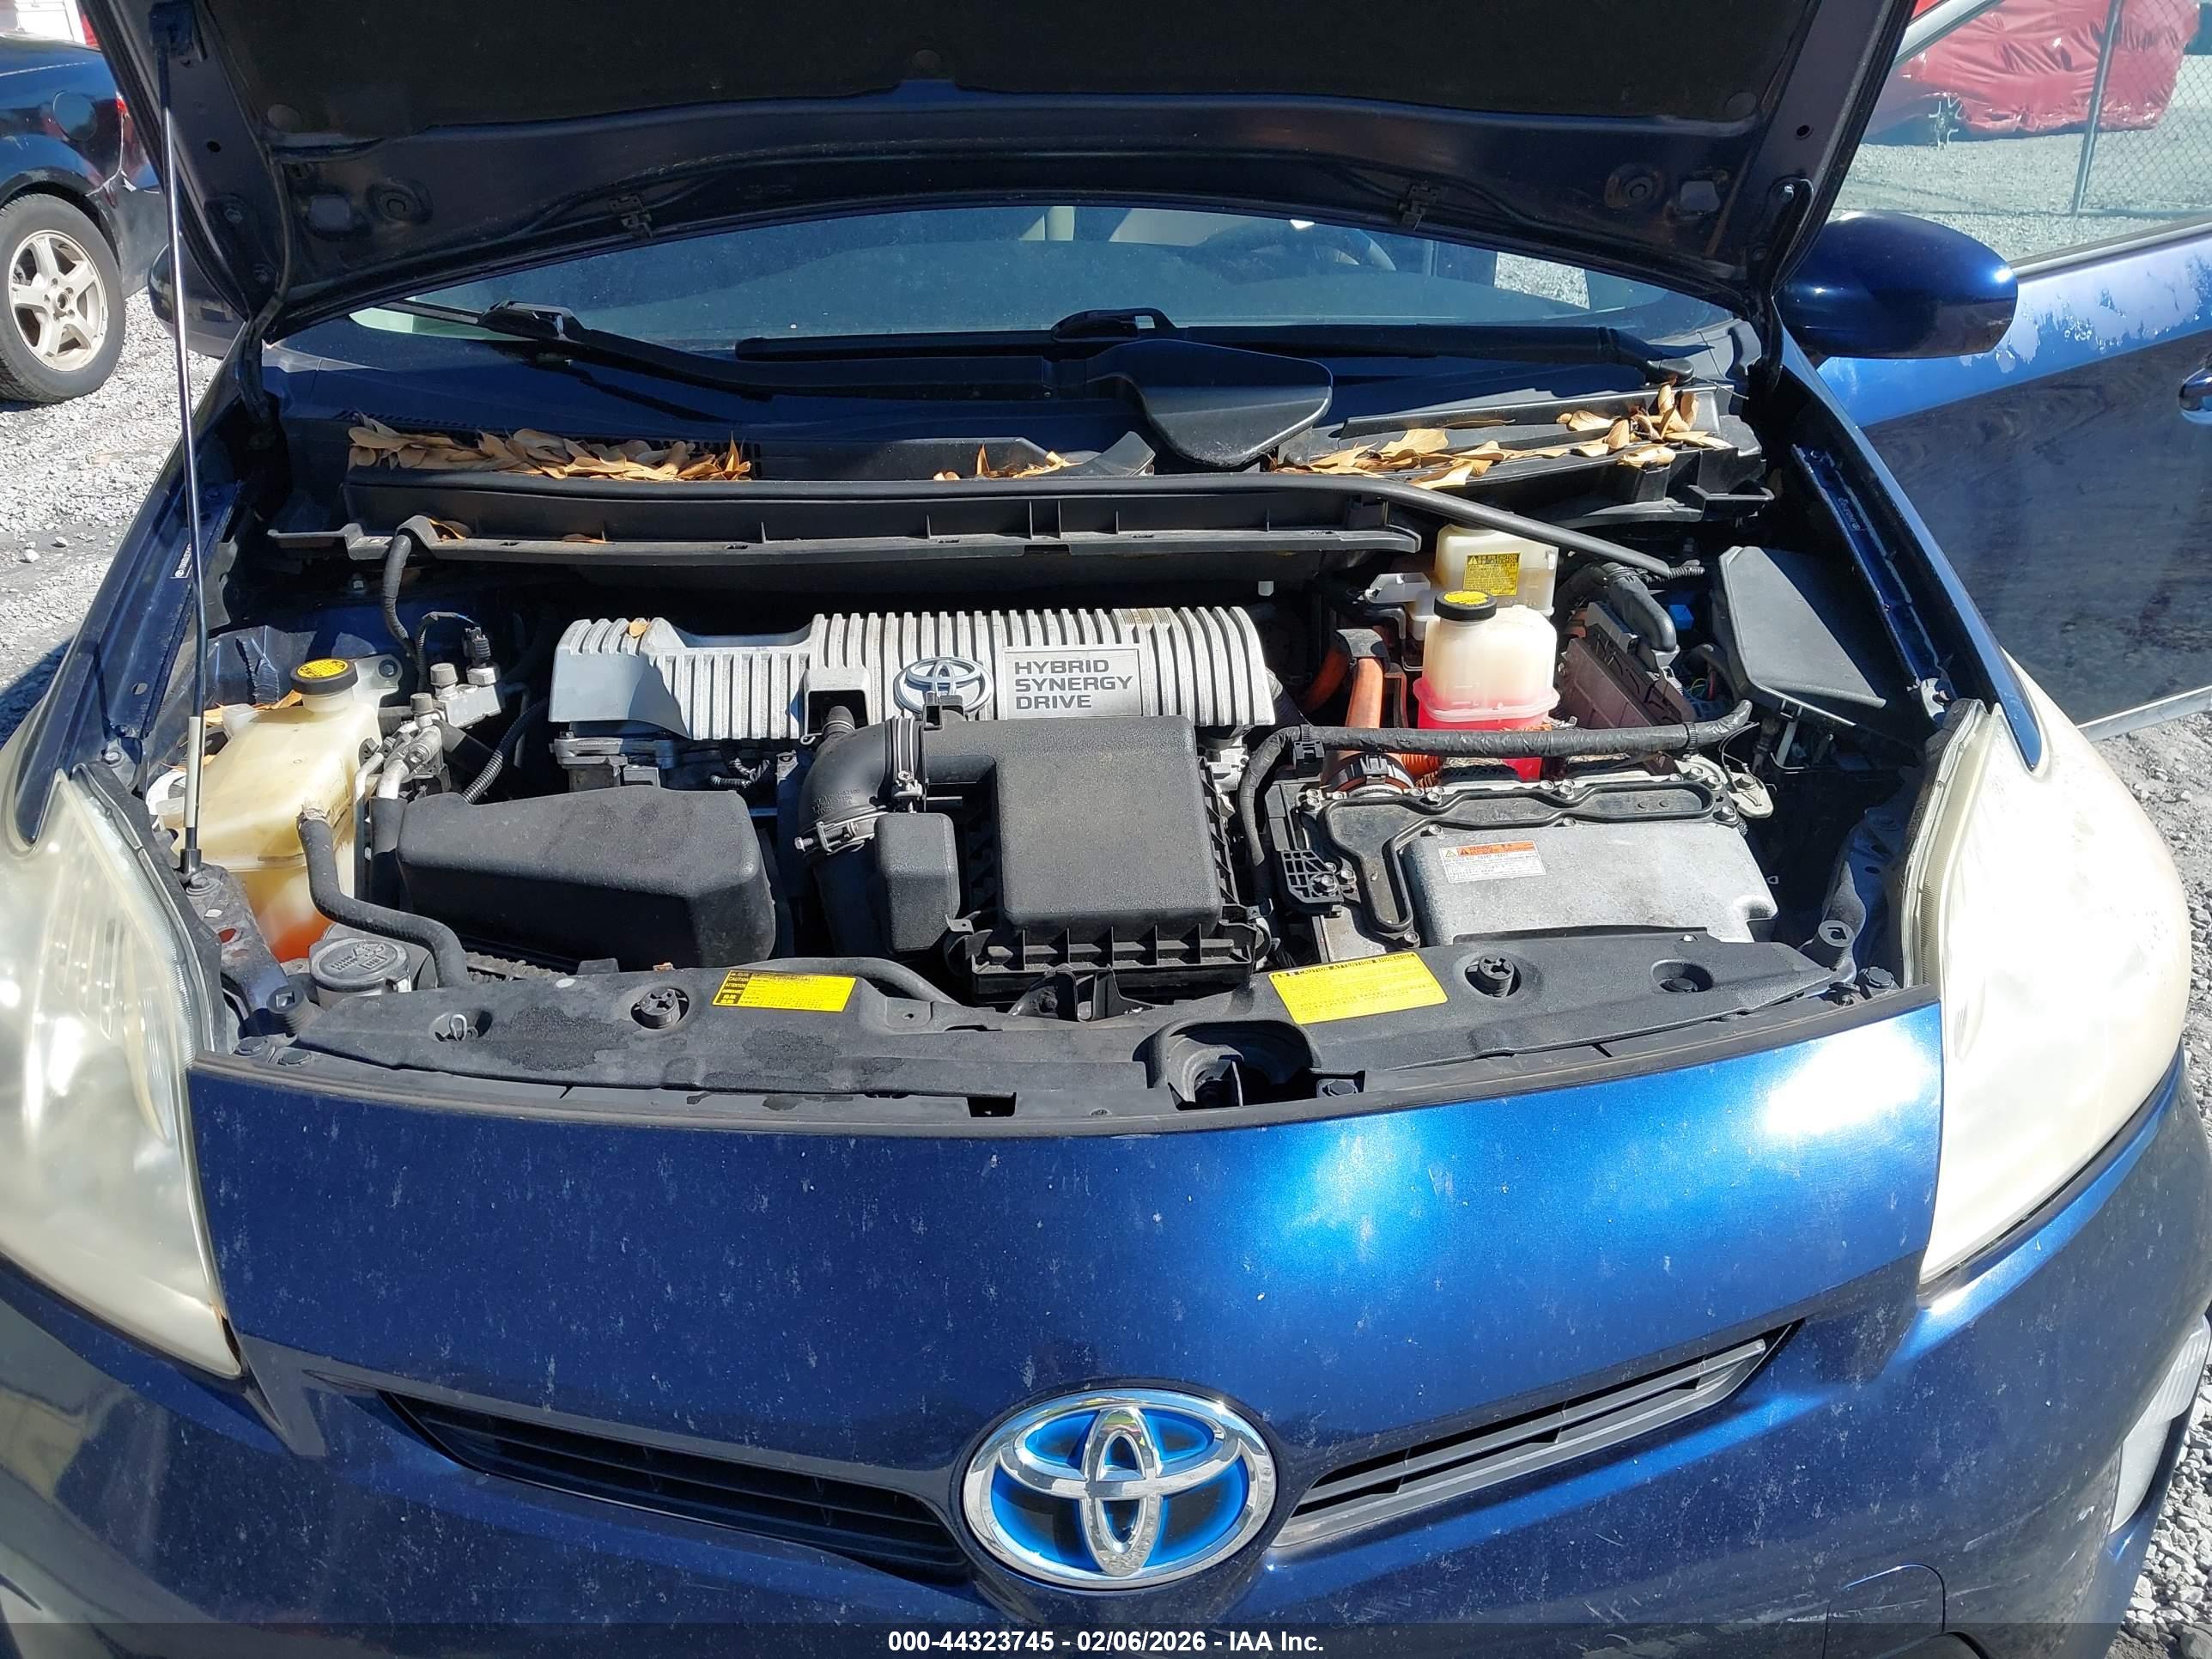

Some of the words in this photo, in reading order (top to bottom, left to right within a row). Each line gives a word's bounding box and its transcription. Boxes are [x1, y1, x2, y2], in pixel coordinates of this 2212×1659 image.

[1014, 659, 1109, 675] HYBRID
[1015, 675, 1133, 692] SYNERGY
[1016, 695, 1092, 710] DRIVE
